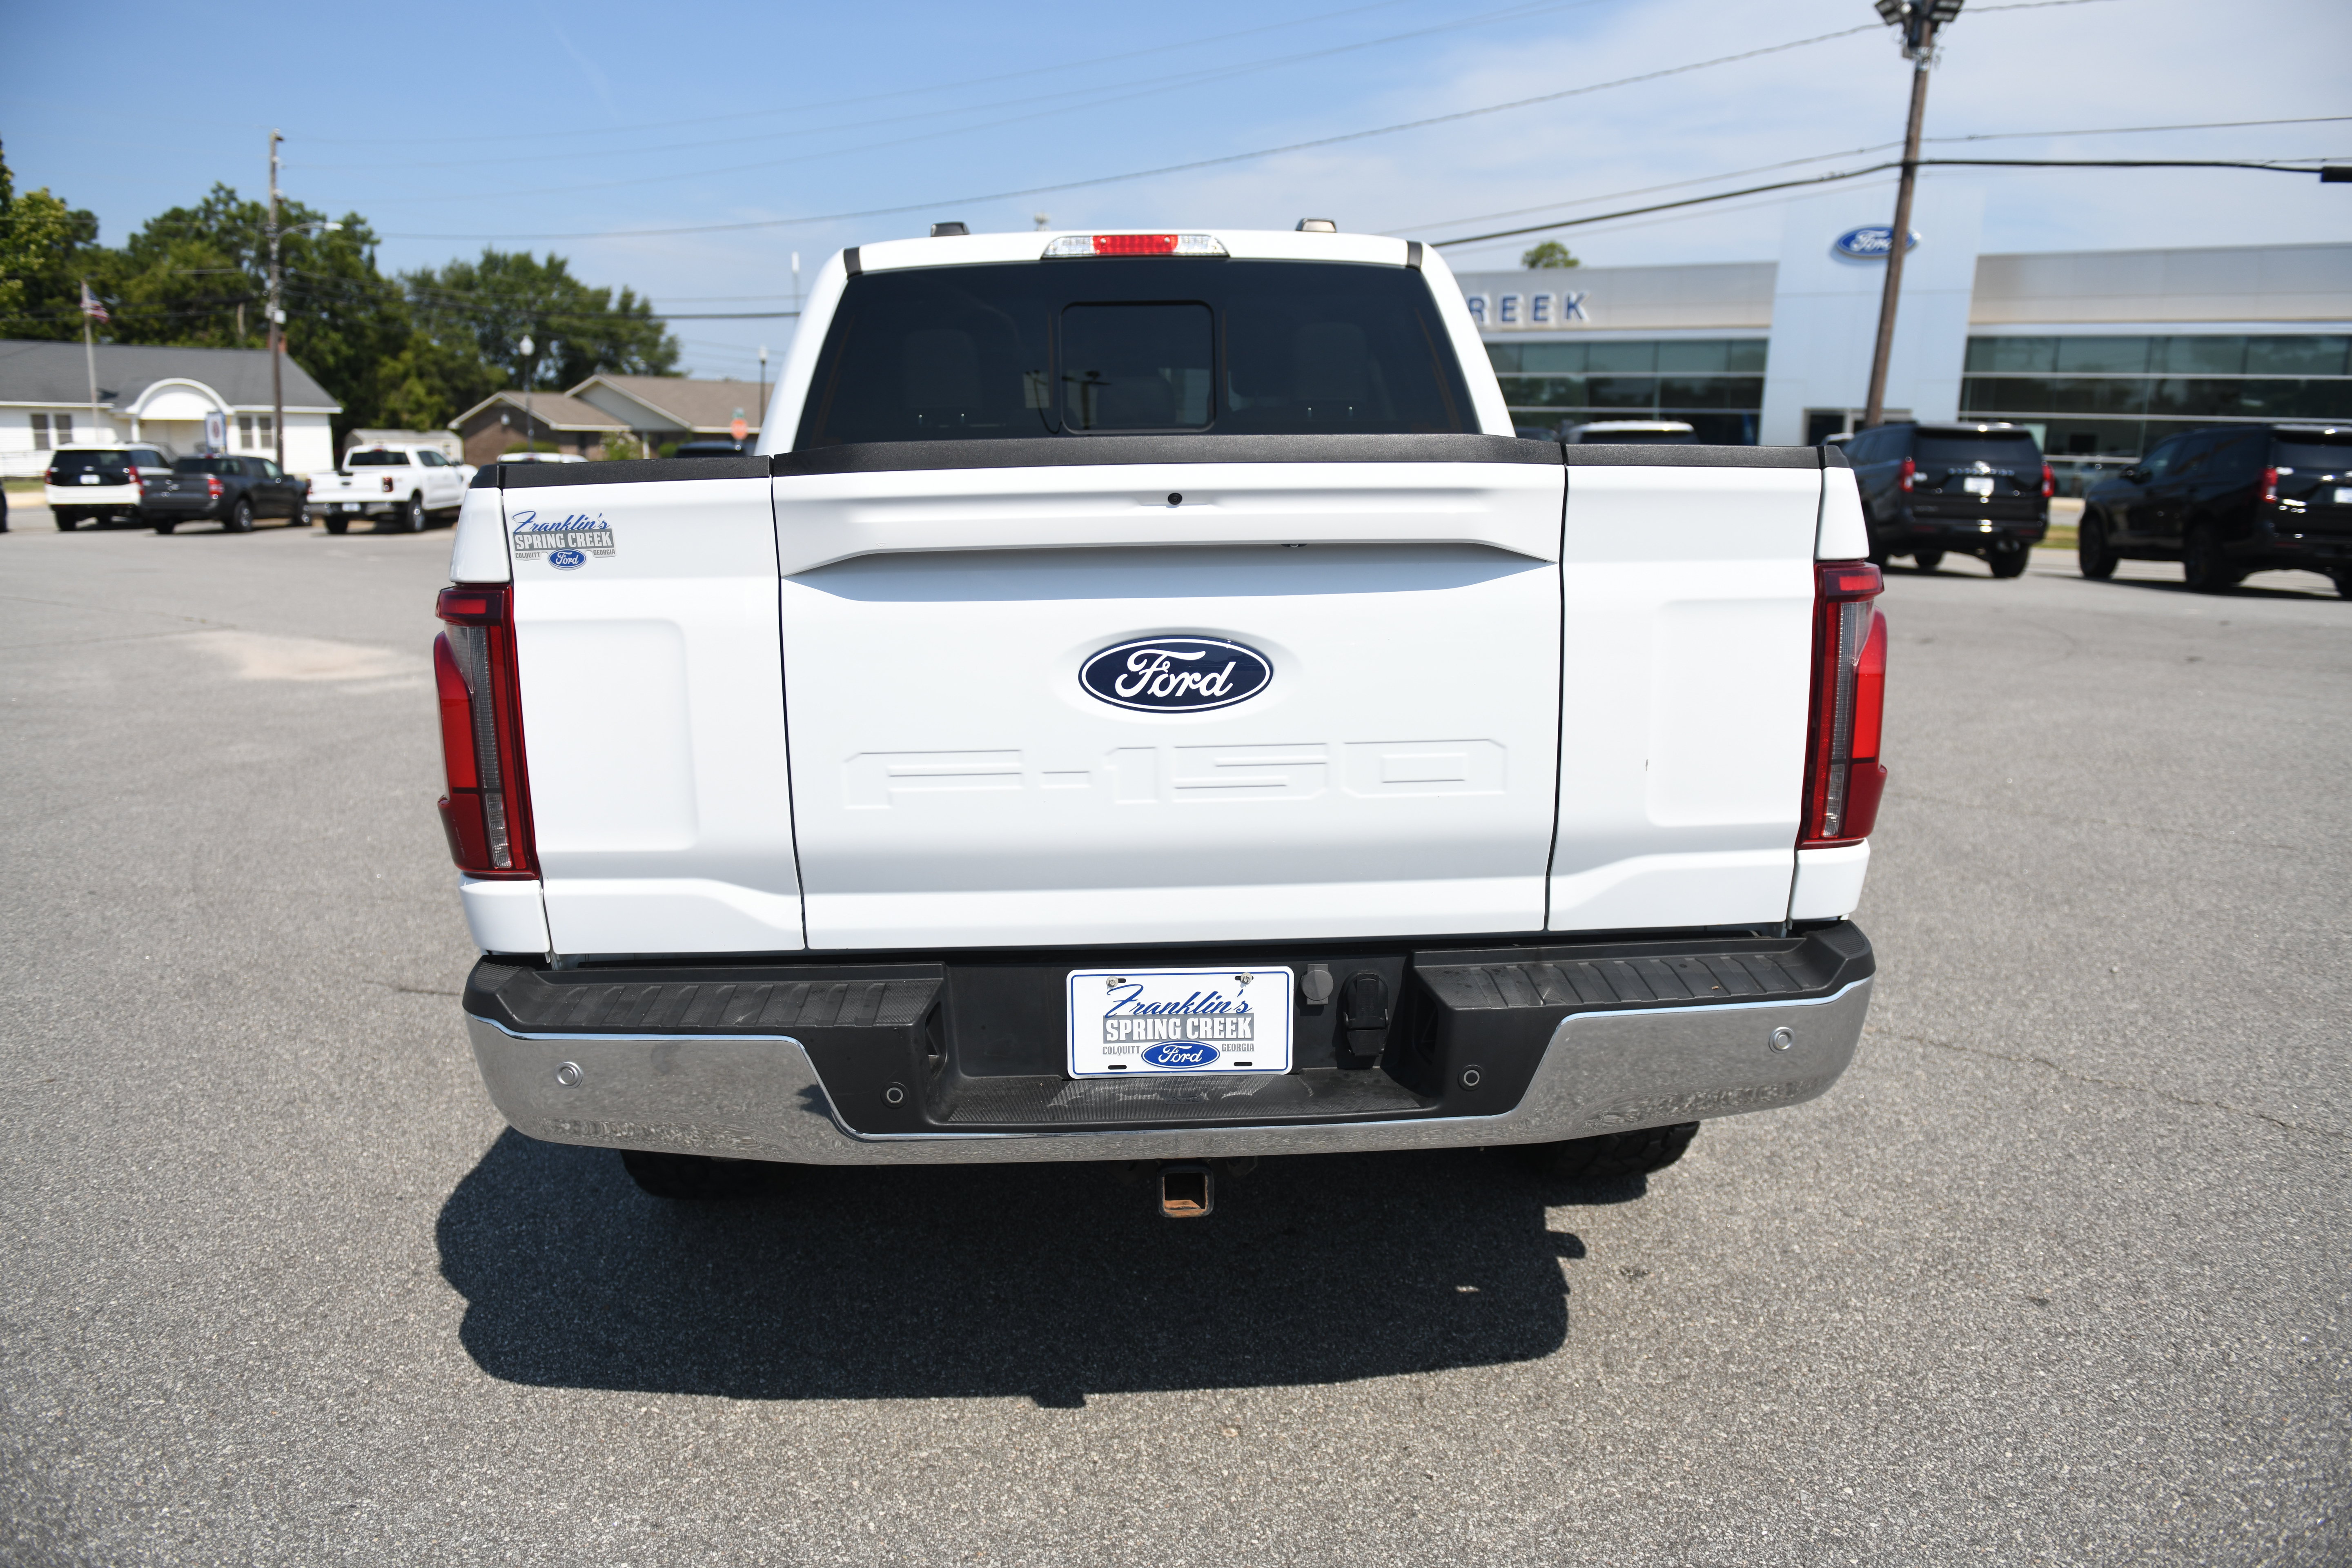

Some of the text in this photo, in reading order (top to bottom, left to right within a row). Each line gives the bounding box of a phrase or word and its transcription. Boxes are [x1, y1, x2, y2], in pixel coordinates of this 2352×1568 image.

[512, 511, 610, 534] Franklin's
[514, 532, 612, 550] SPRING CREEK
[555, 552, 579, 565] Ford
[1114, 649, 1236, 697] Ford
[841, 739, 1508, 809] F-150
[1105, 984, 1253, 1018] Franklin's
[1105, 1017, 1252, 1042] SPRING CREEK
[1102, 1043, 1255, 1055] COLQUITT GEORGIA
[1158, 1045, 1203, 1063] Ford
